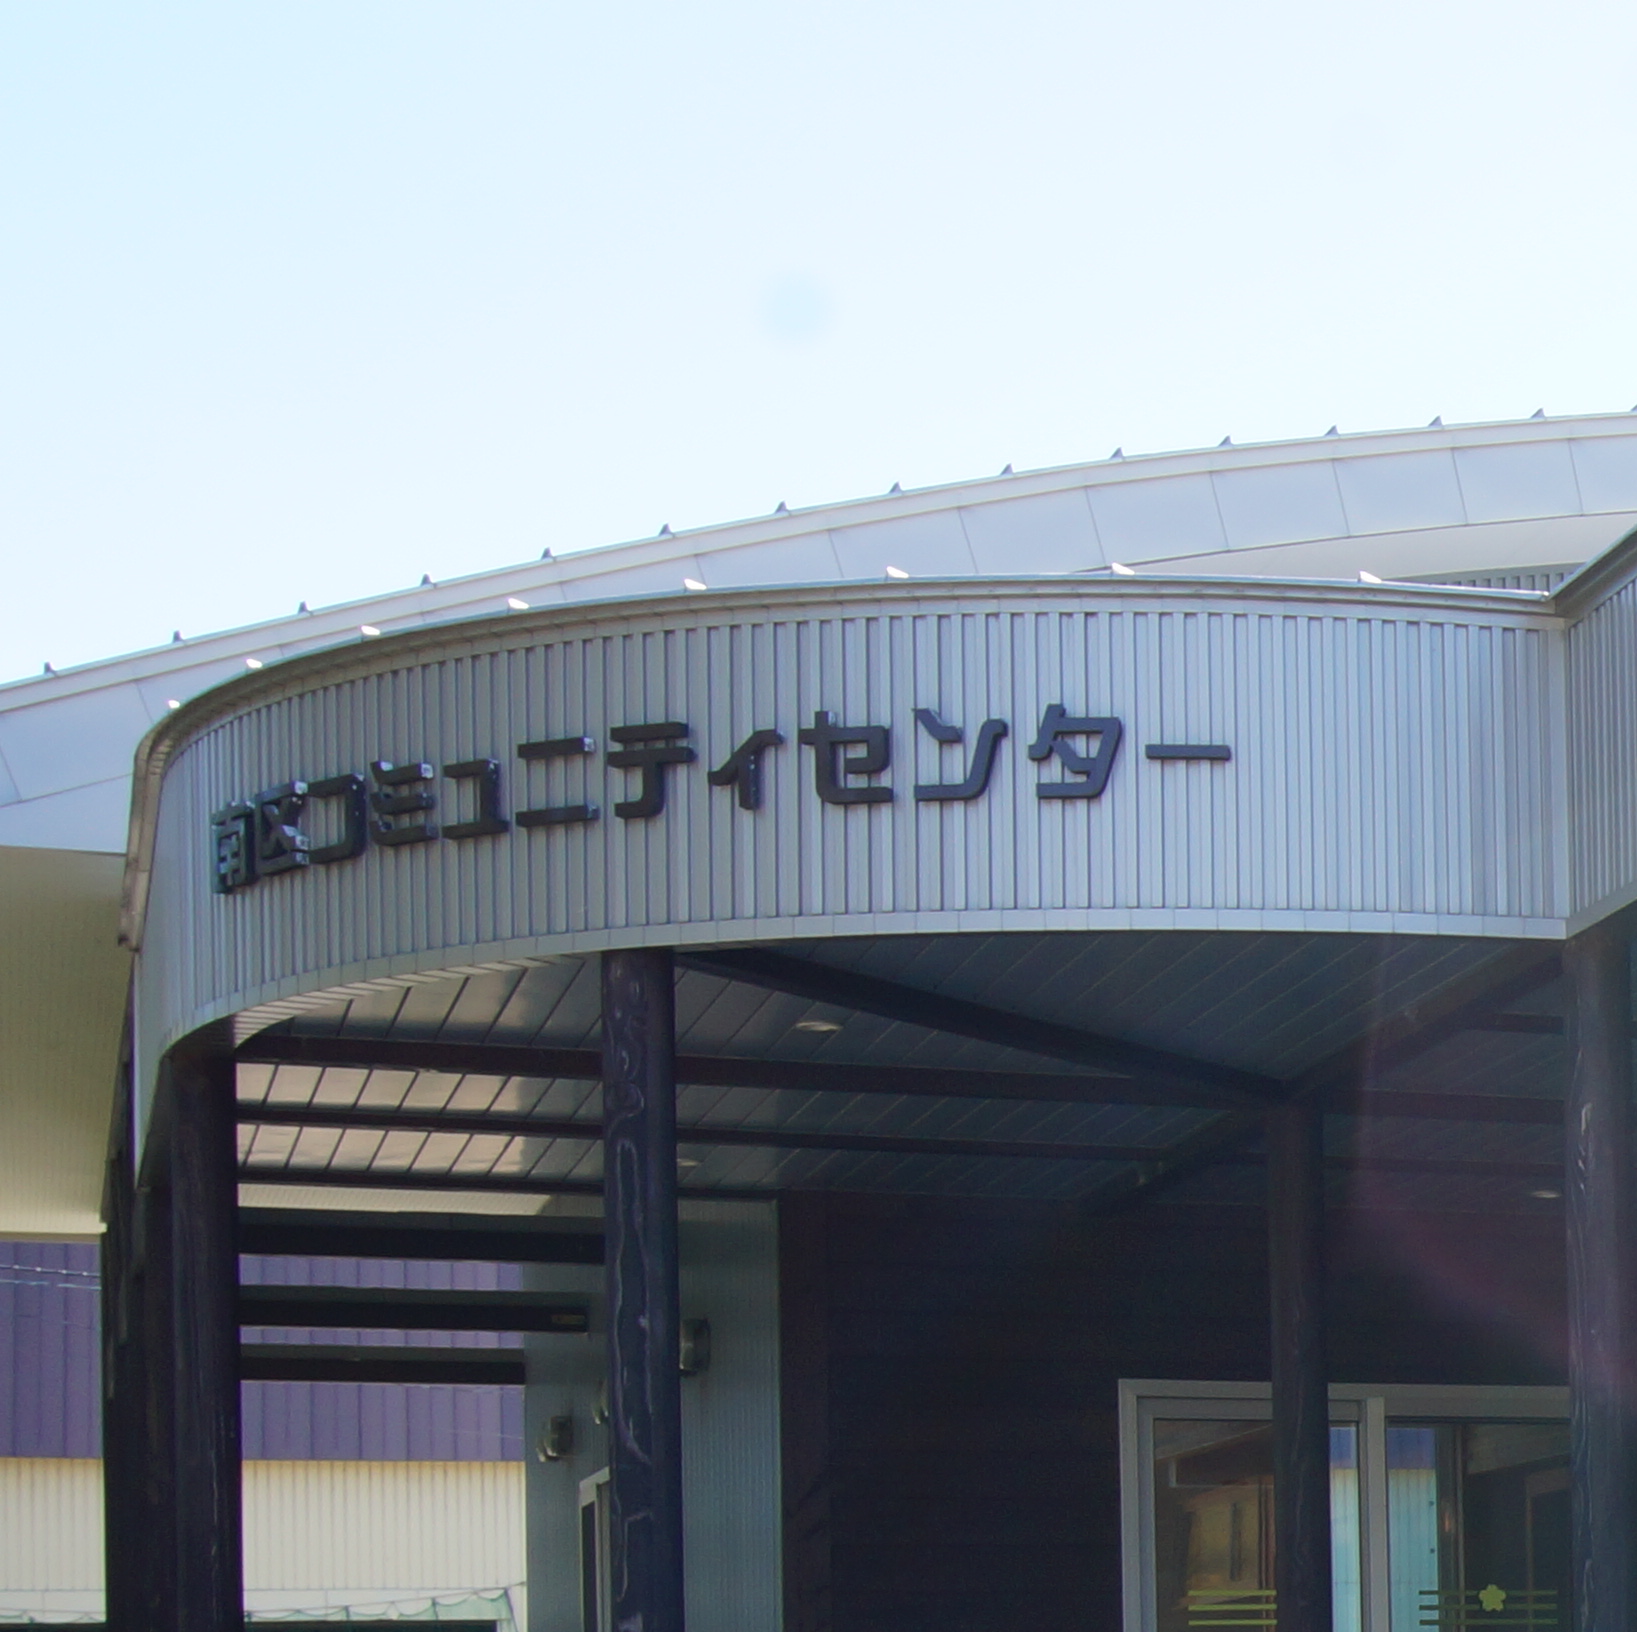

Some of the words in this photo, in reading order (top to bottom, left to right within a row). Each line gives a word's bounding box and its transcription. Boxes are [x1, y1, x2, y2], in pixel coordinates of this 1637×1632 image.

[211, 704, 1231, 893] 南区コミュニティセンター
